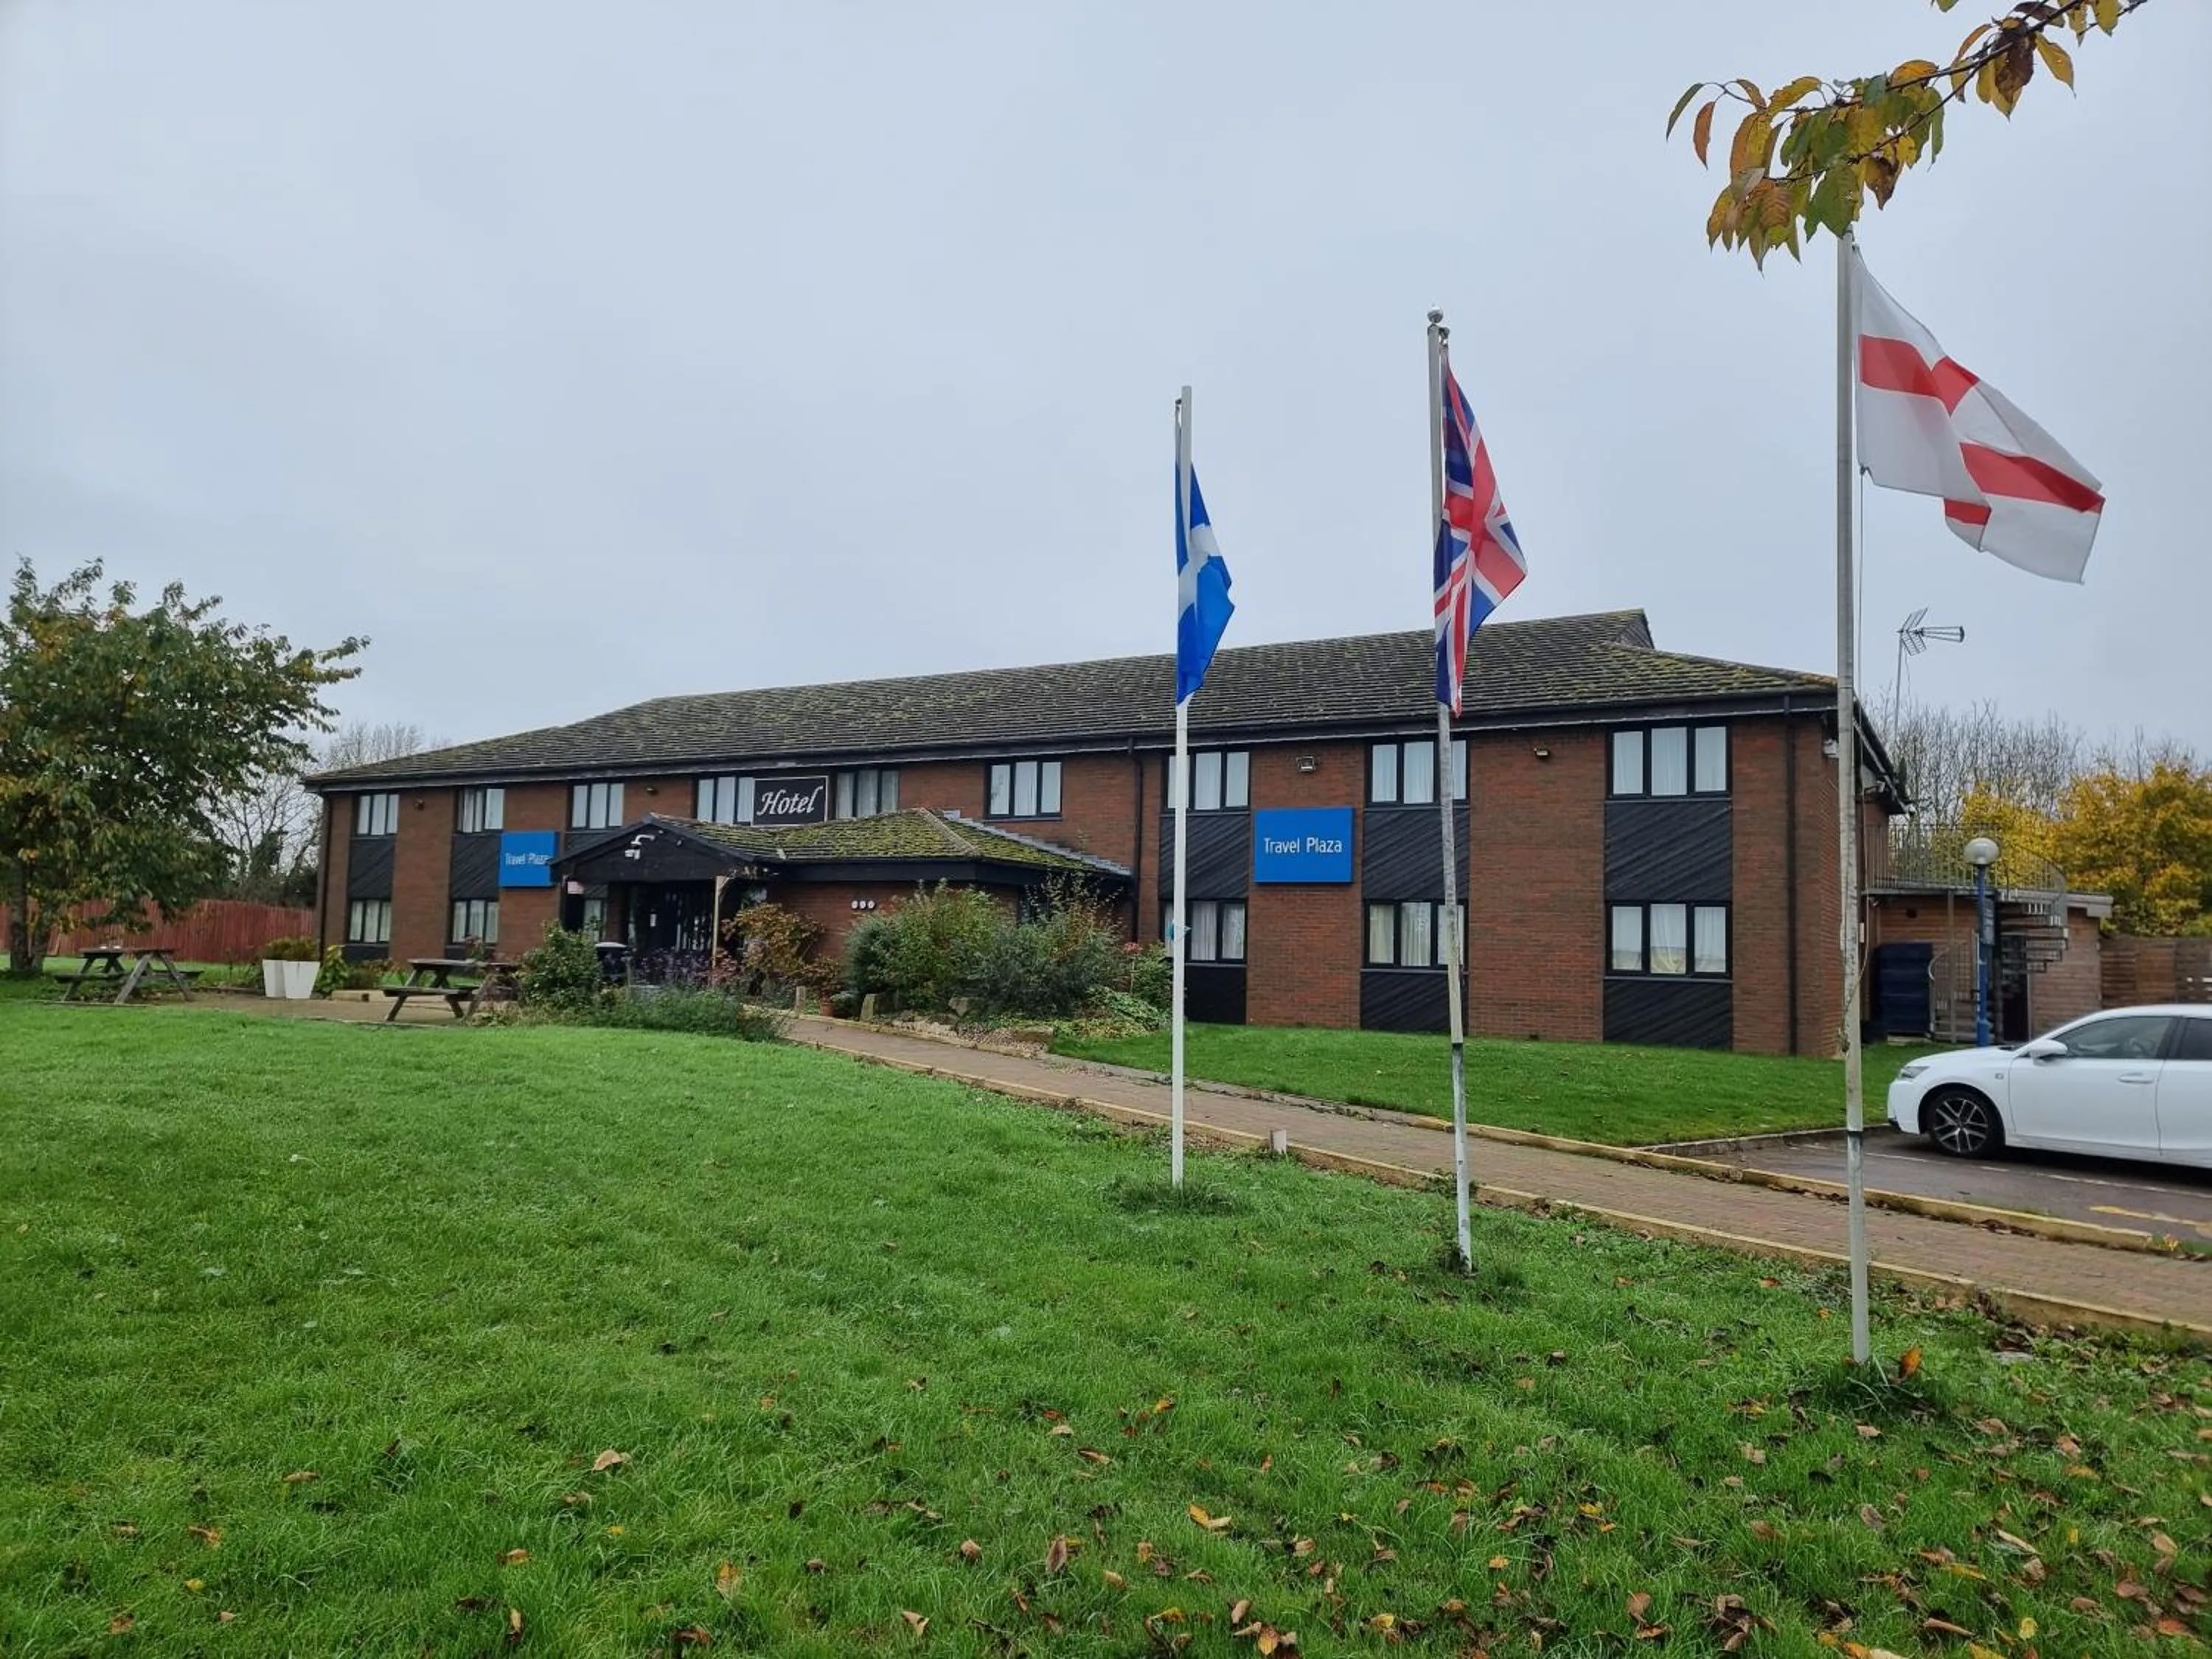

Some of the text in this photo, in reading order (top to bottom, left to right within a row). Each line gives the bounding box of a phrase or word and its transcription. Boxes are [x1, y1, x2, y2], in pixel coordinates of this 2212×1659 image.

[756, 785, 823, 815] Hotel
[1264, 837, 1343, 853] Travel Plaza
[504, 852, 526, 866] Travel
